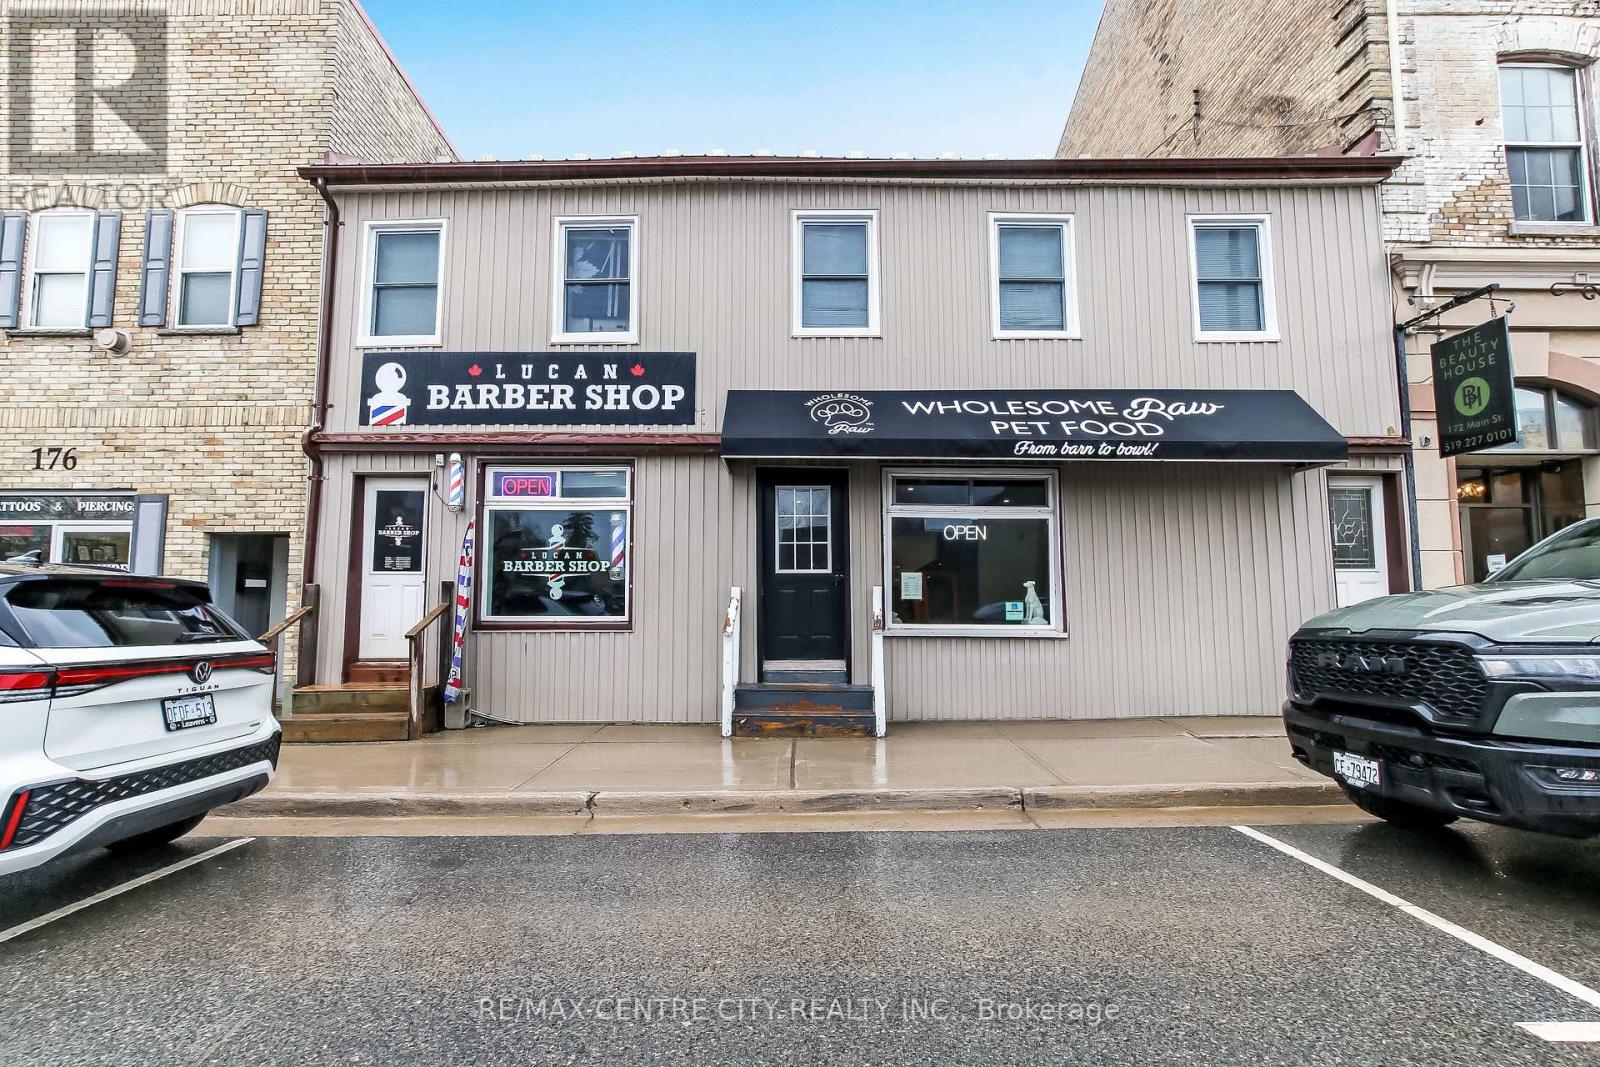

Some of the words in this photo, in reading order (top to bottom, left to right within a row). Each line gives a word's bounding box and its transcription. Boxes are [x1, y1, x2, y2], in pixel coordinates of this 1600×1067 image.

[1452, 331, 1481, 350] THE
[1440, 339, 1498, 368] BEAUTY
[496, 364, 618, 379] LUCAN
[1444, 353, 1497, 380] HOUSE
[427, 384, 577, 410] BARBER
[586, 384, 685, 410] SHOP
[804, 393, 874, 407] WHOLESOME
[902, 400, 1118, 415] WHOLESOME
[1122, 397, 1225, 420] Raw
[828, 424, 874, 434] Raw
[990, 420, 1050, 435] PET
[1060, 420, 1164, 436] FOOD
[1448, 423, 1464, 434] 172
[1466, 418, 1490, 430] Main
[1492, 414, 1505, 424] St.
[1014, 440, 1057, 455] From
[1060, 441, 1096, 455] barn
[1097, 442, 1115, 455] to
[1116, 442, 1159, 455] bowl!
[31, 447, 77, 470] 176
[503, 479, 550, 495] OPEN
[54, 501, 63, 511] &
[944, 525, 987, 541] OPEN
[503, 560, 565, 572] BARBER
[568, 560, 610, 572] SHOP
[177, 684, 219, 693] TIGUAN
